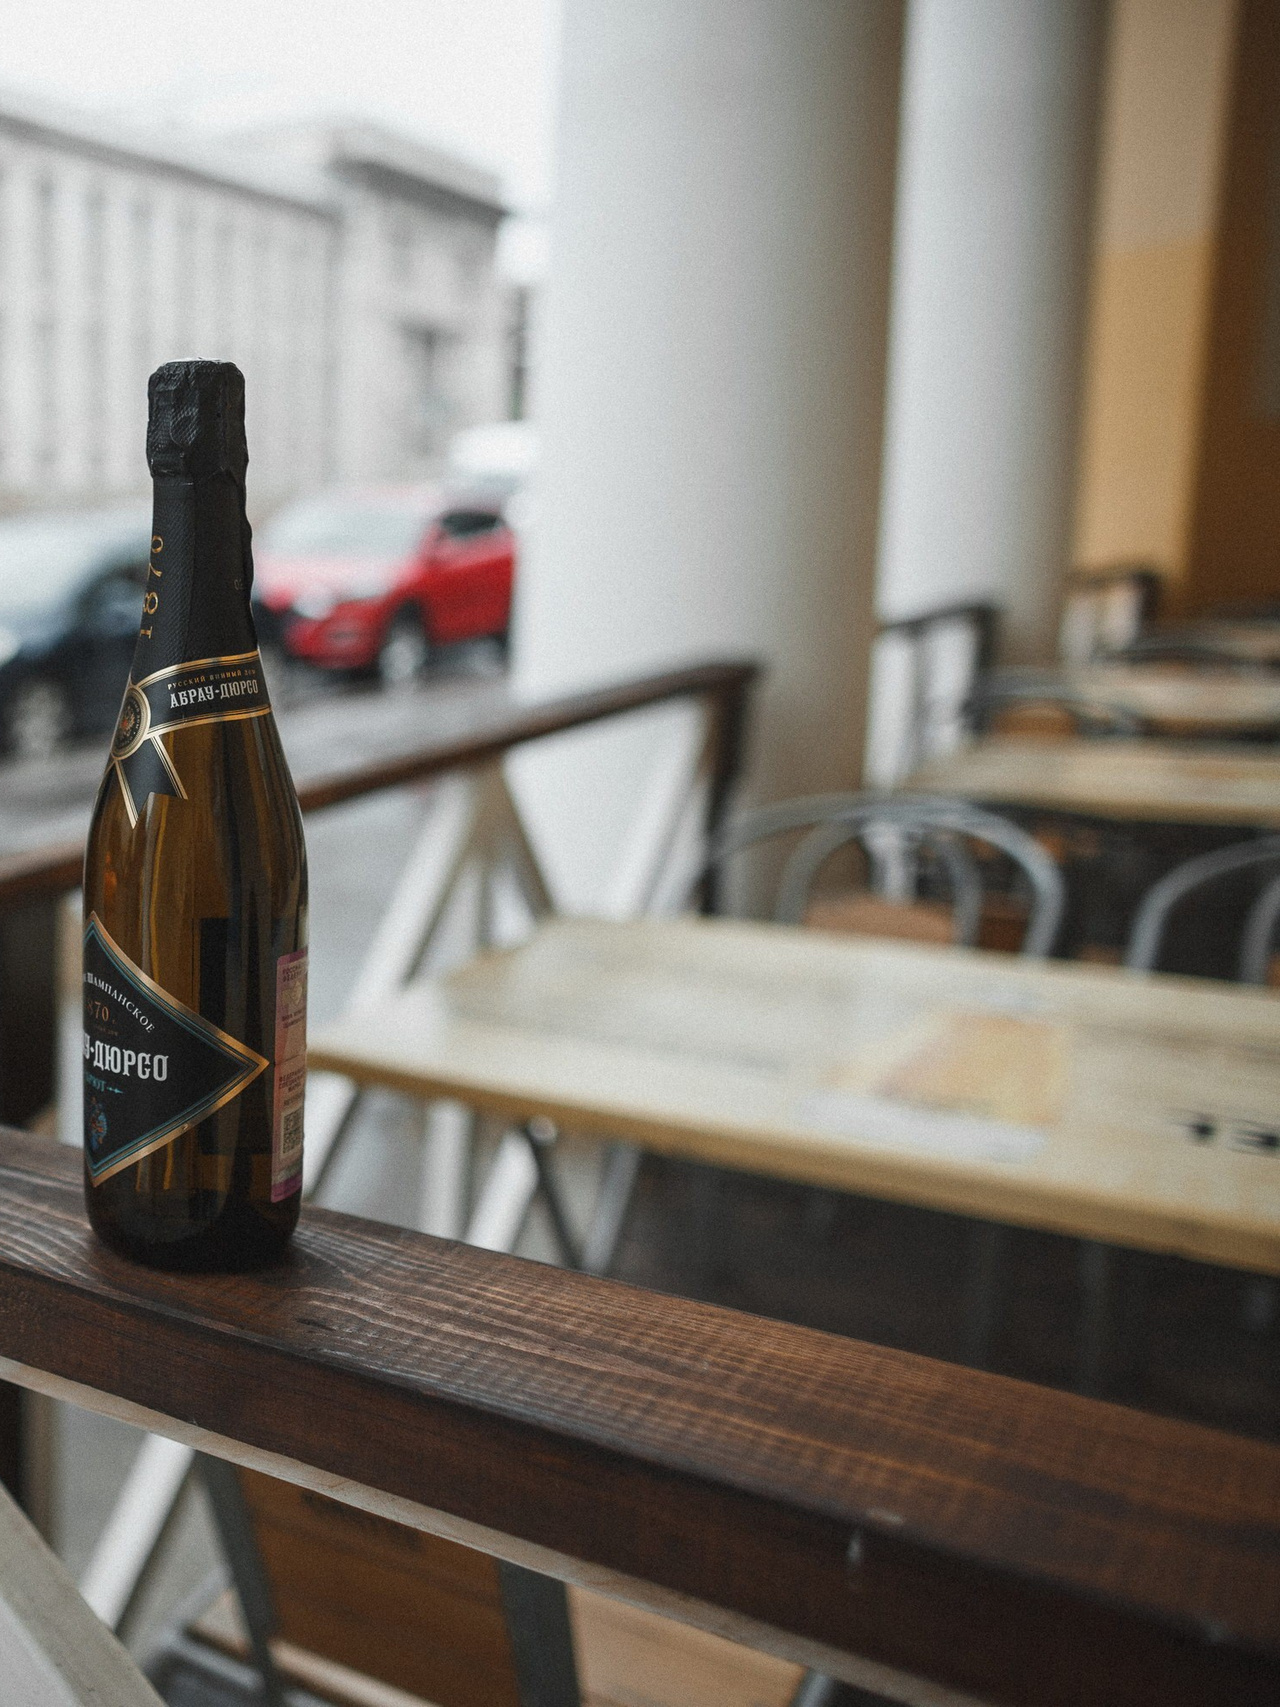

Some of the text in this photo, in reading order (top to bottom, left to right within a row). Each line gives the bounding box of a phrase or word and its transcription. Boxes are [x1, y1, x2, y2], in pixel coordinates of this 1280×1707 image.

[140, 534, 164, 640] 1870
[167, 675, 206, 690] РУССКИЙ
[170, 679, 259, 709] АБРАУ-ДЮРСО
[87, 972, 156, 1034] ШАМПАНСКОЕ
